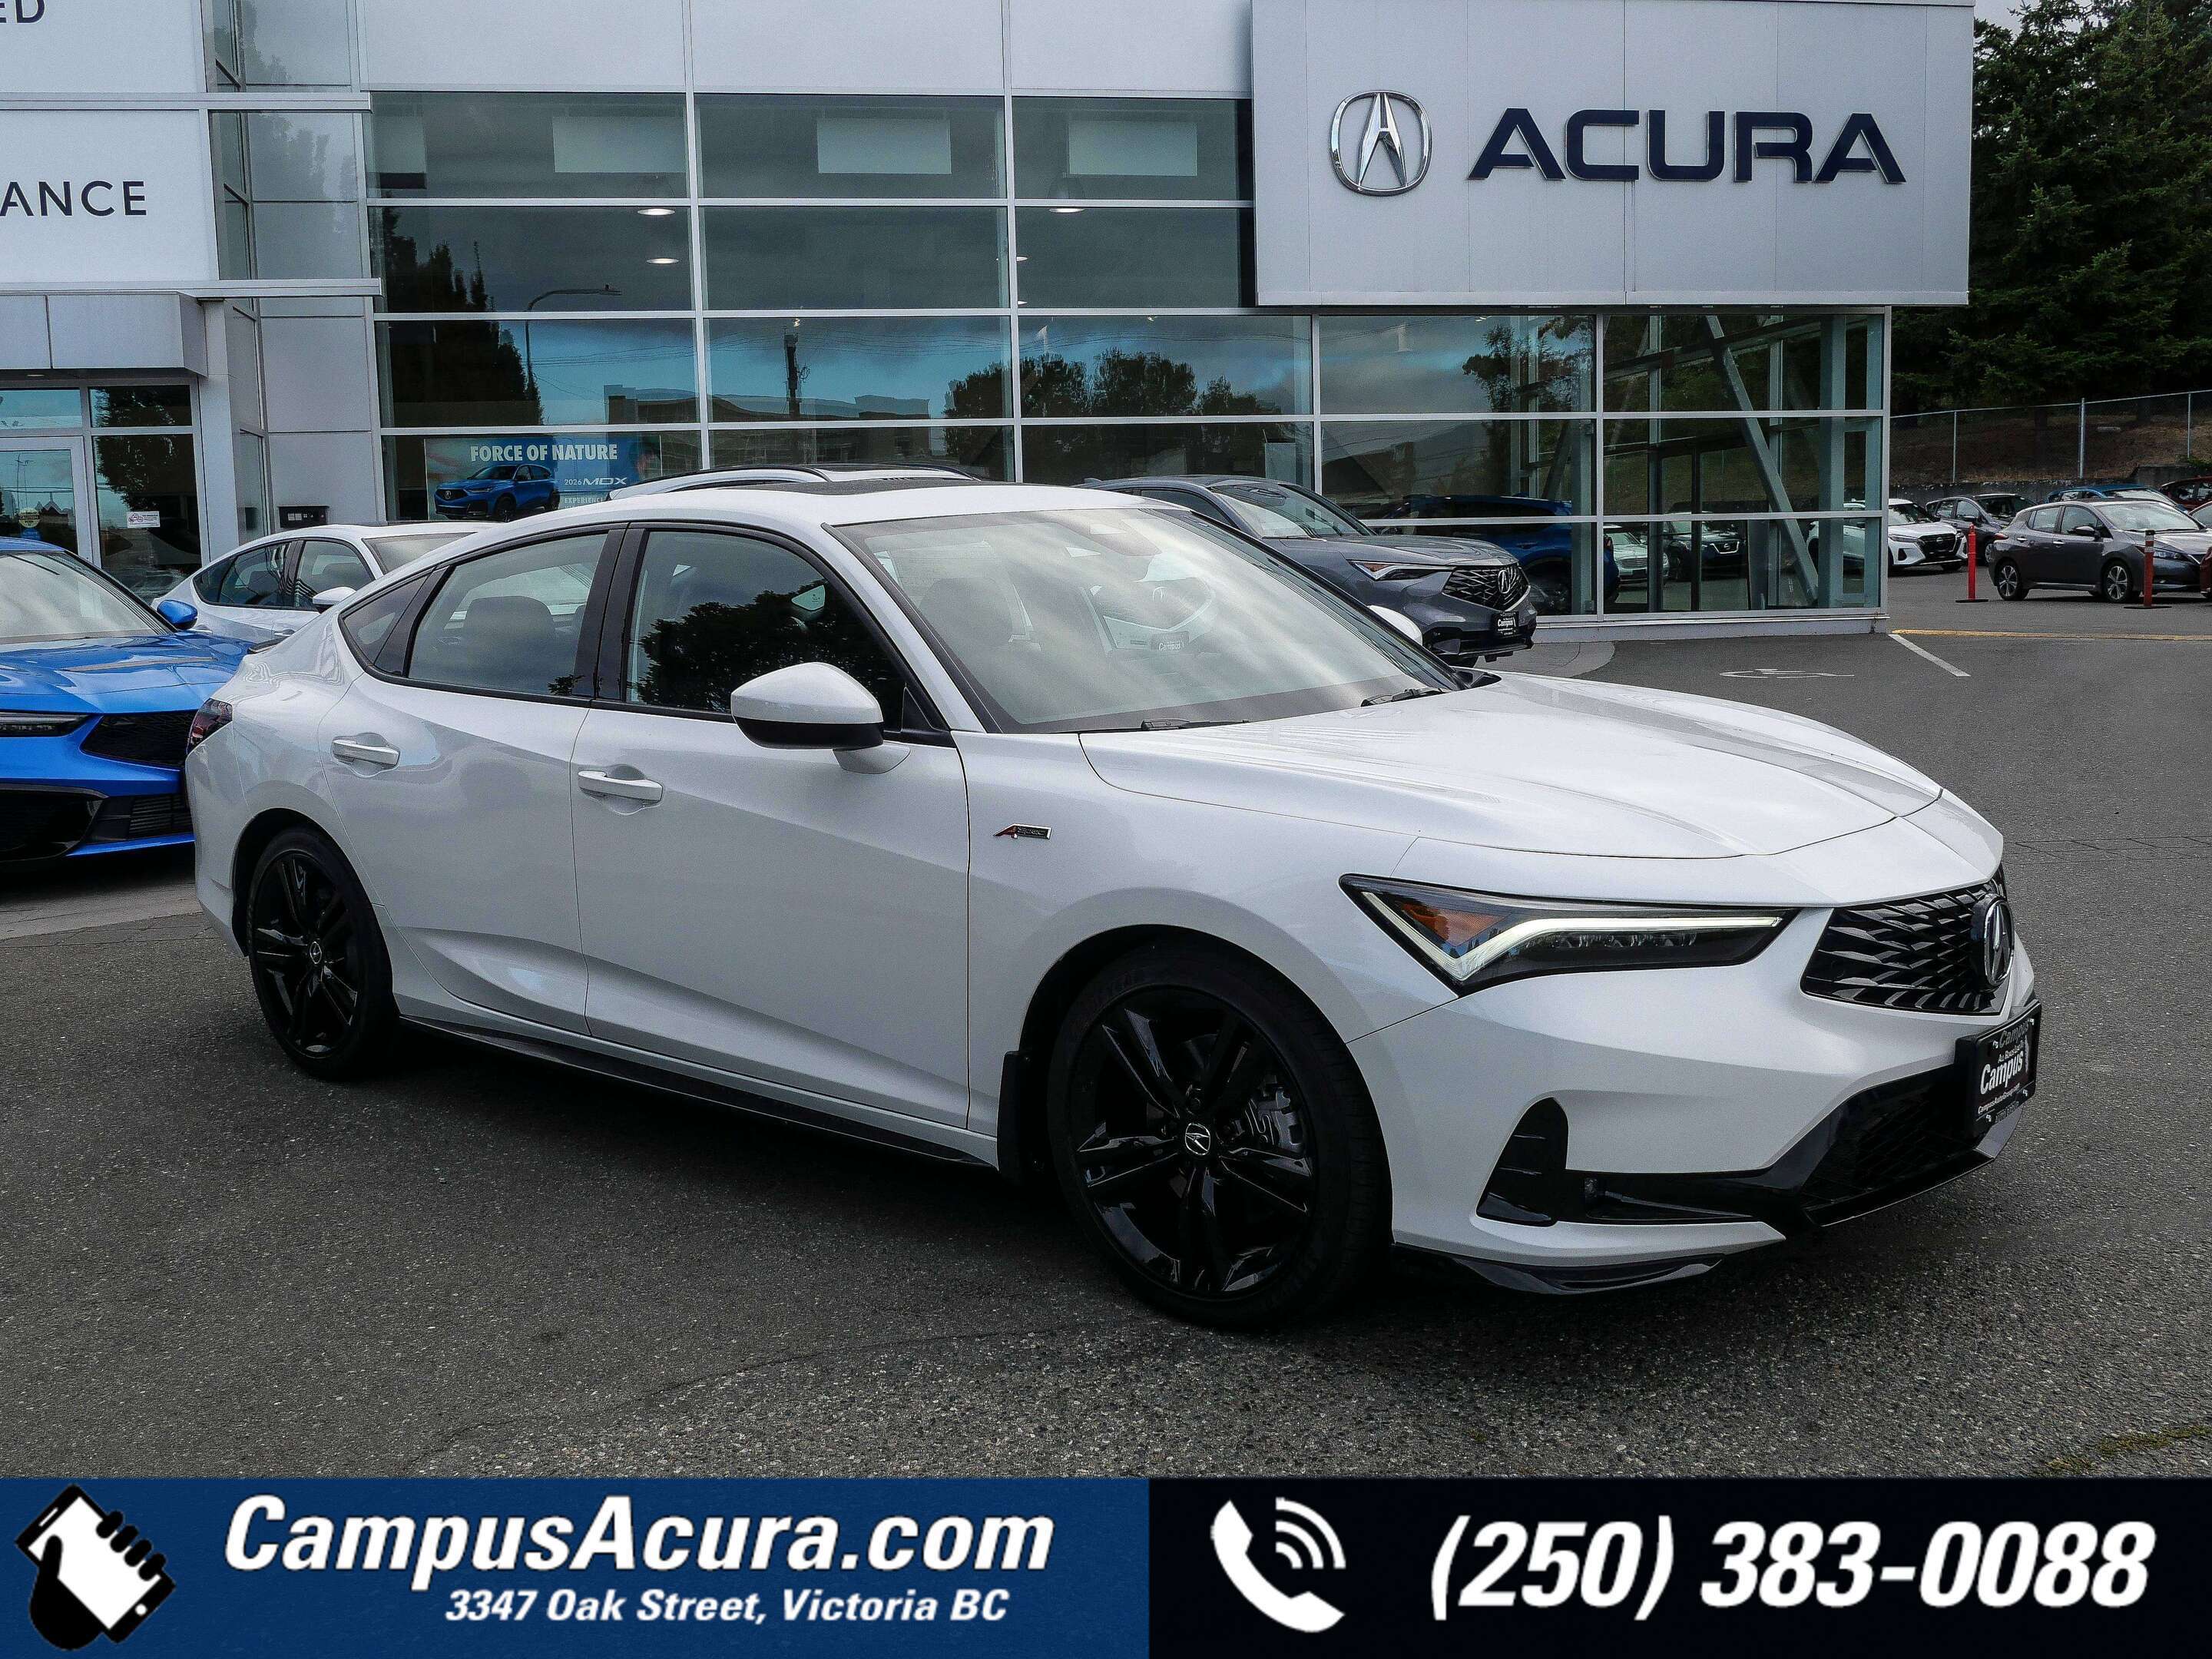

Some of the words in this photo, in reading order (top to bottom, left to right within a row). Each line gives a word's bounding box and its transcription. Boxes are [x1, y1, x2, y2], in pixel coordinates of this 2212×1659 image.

[1467, 107, 1907, 184] ACURA
[0, 180, 147, 217] ANCE
[470, 444, 522, 462] FORCE
[527, 444, 548, 461] OF
[551, 443, 618, 461] NATURE
[583, 477, 628, 485] MDX
[1981, 1050, 2024, 1094] Campus
